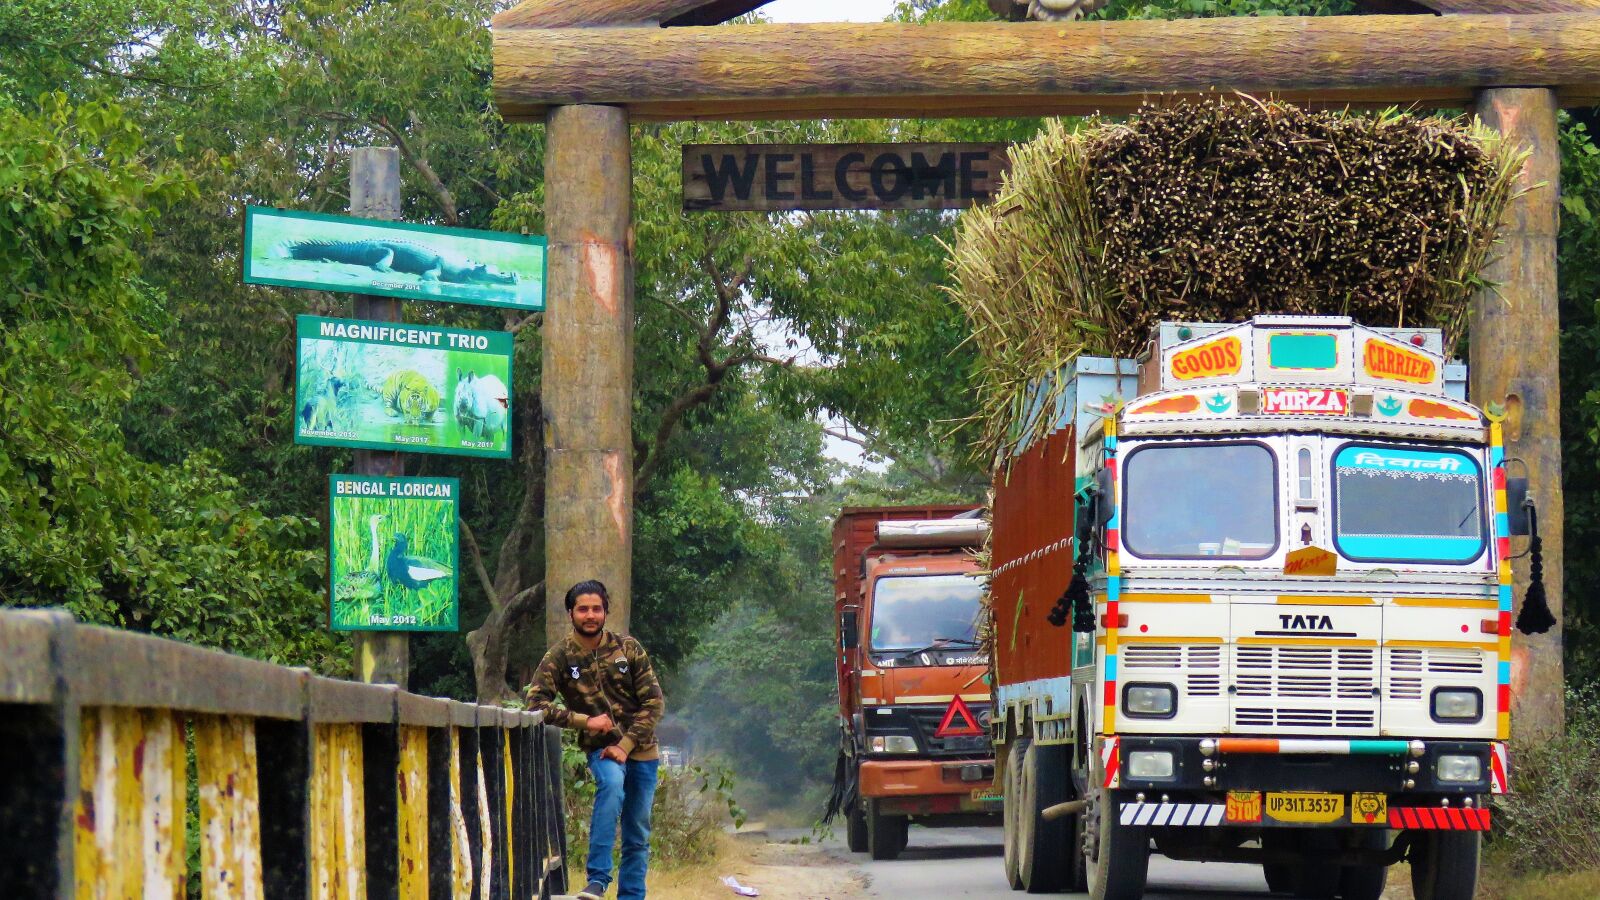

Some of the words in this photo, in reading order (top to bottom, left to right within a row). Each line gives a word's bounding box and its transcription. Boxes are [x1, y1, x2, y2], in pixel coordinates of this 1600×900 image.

[701, 151, 989, 201] WELCOME
[372, 280, 403, 289] December
[320, 322, 442, 346] MAGNIFICENT
[447, 333, 488, 350] TRIO
[1173, 341, 1238, 375] GOODS
[1368, 346, 1431, 378] CARRIER
[1266, 390, 1343, 412] MIRZA
[301, 428, 337, 437] November
[395, 435, 409, 443] May
[1354, 452, 1462, 471] दिवानी
[336, 480, 386, 496] BENGAL
[389, 482, 451, 497] FLORICAN
[370, 615, 390, 626] May
[393, 615, 416, 624] 2012
[1279, 614, 1334, 630] TATA
[1227, 801, 1261, 821] STOP
